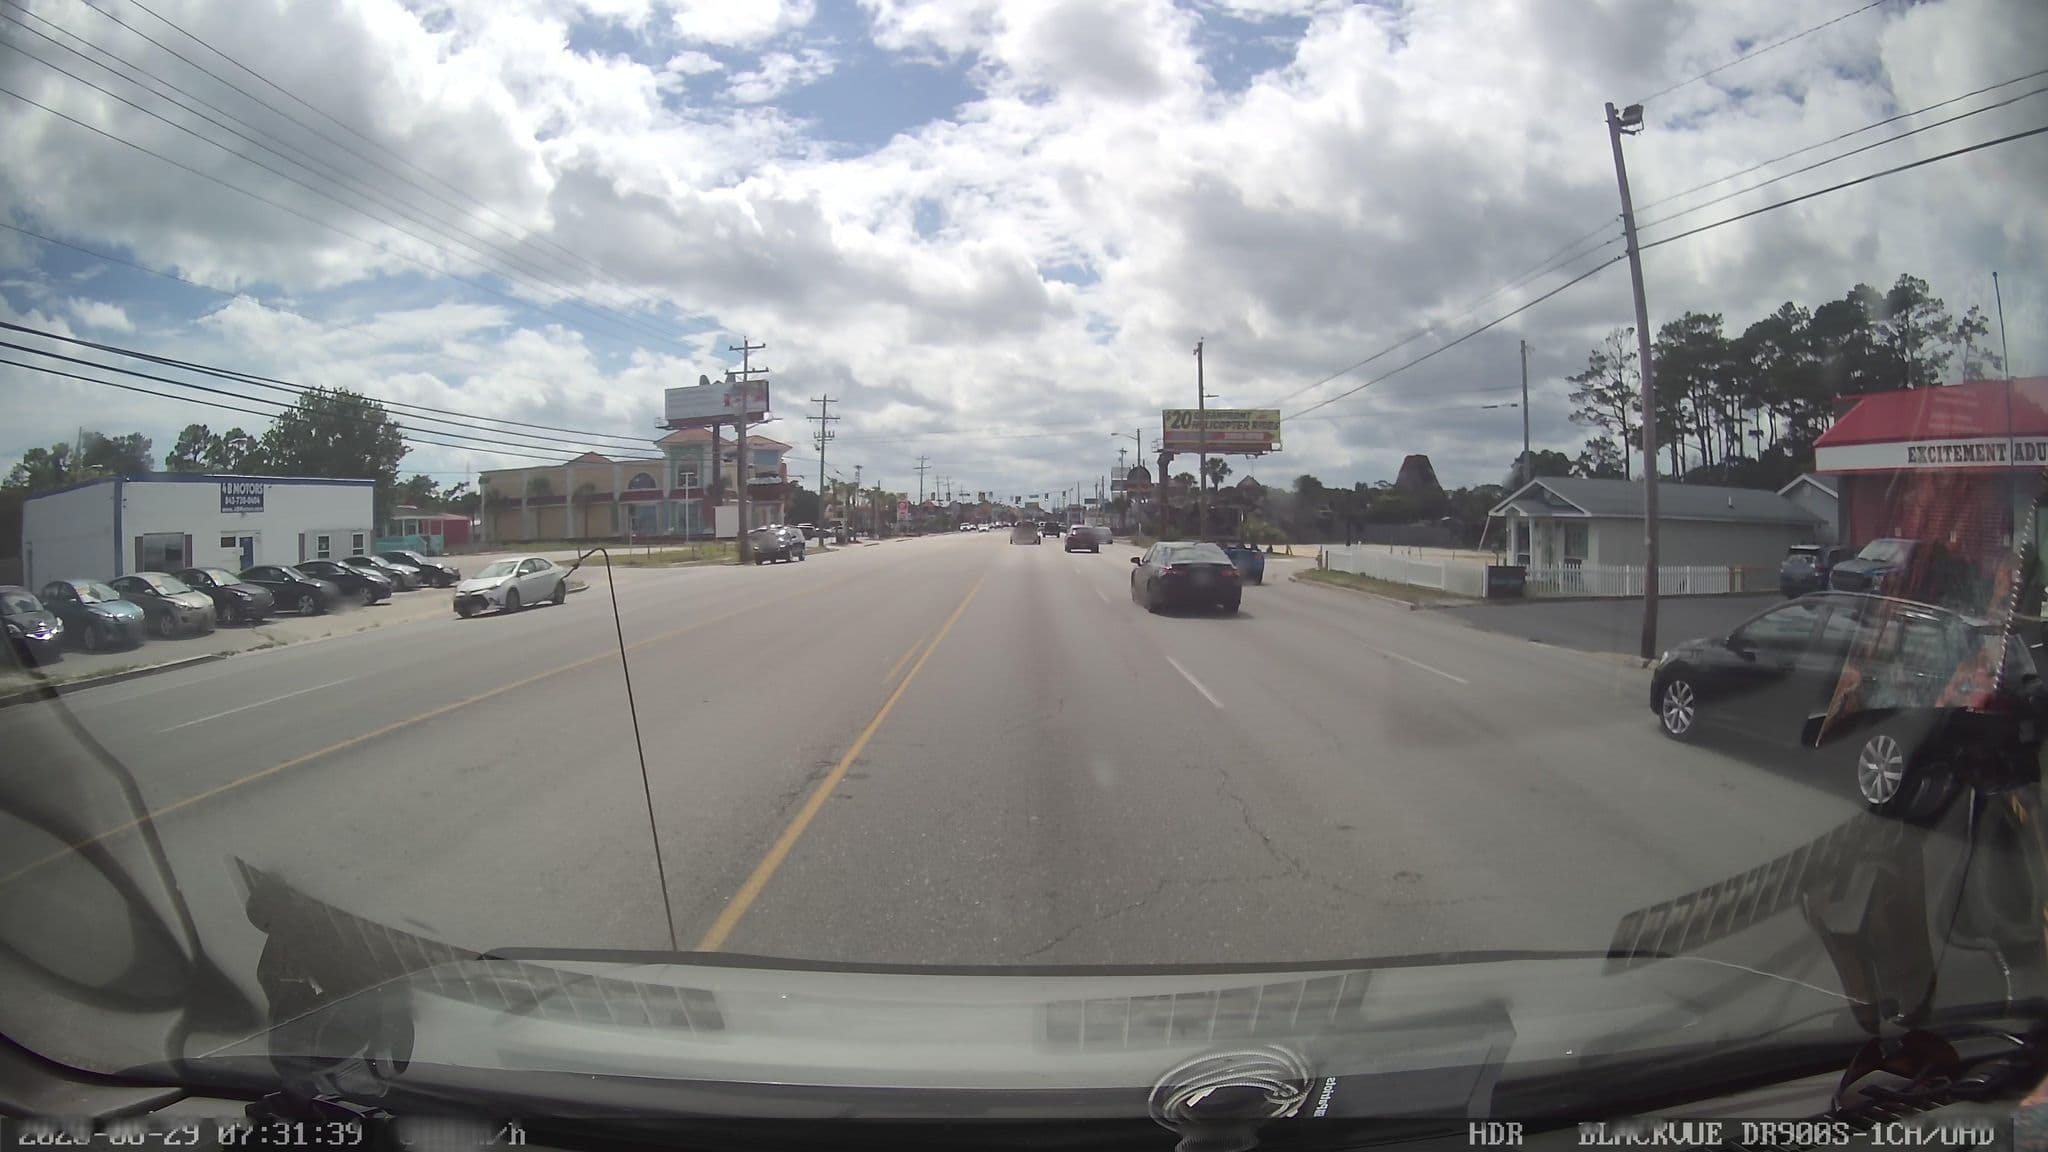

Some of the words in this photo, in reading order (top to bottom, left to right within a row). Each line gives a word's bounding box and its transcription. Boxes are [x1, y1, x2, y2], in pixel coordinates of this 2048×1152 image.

[1192, 420, 1250, 430] HLICOPTER
[1908, 443, 2007, 463] EXCITEMENT
[2014, 442, 2048, 461] ADU
[233, 483, 263, 494] MOTORS
